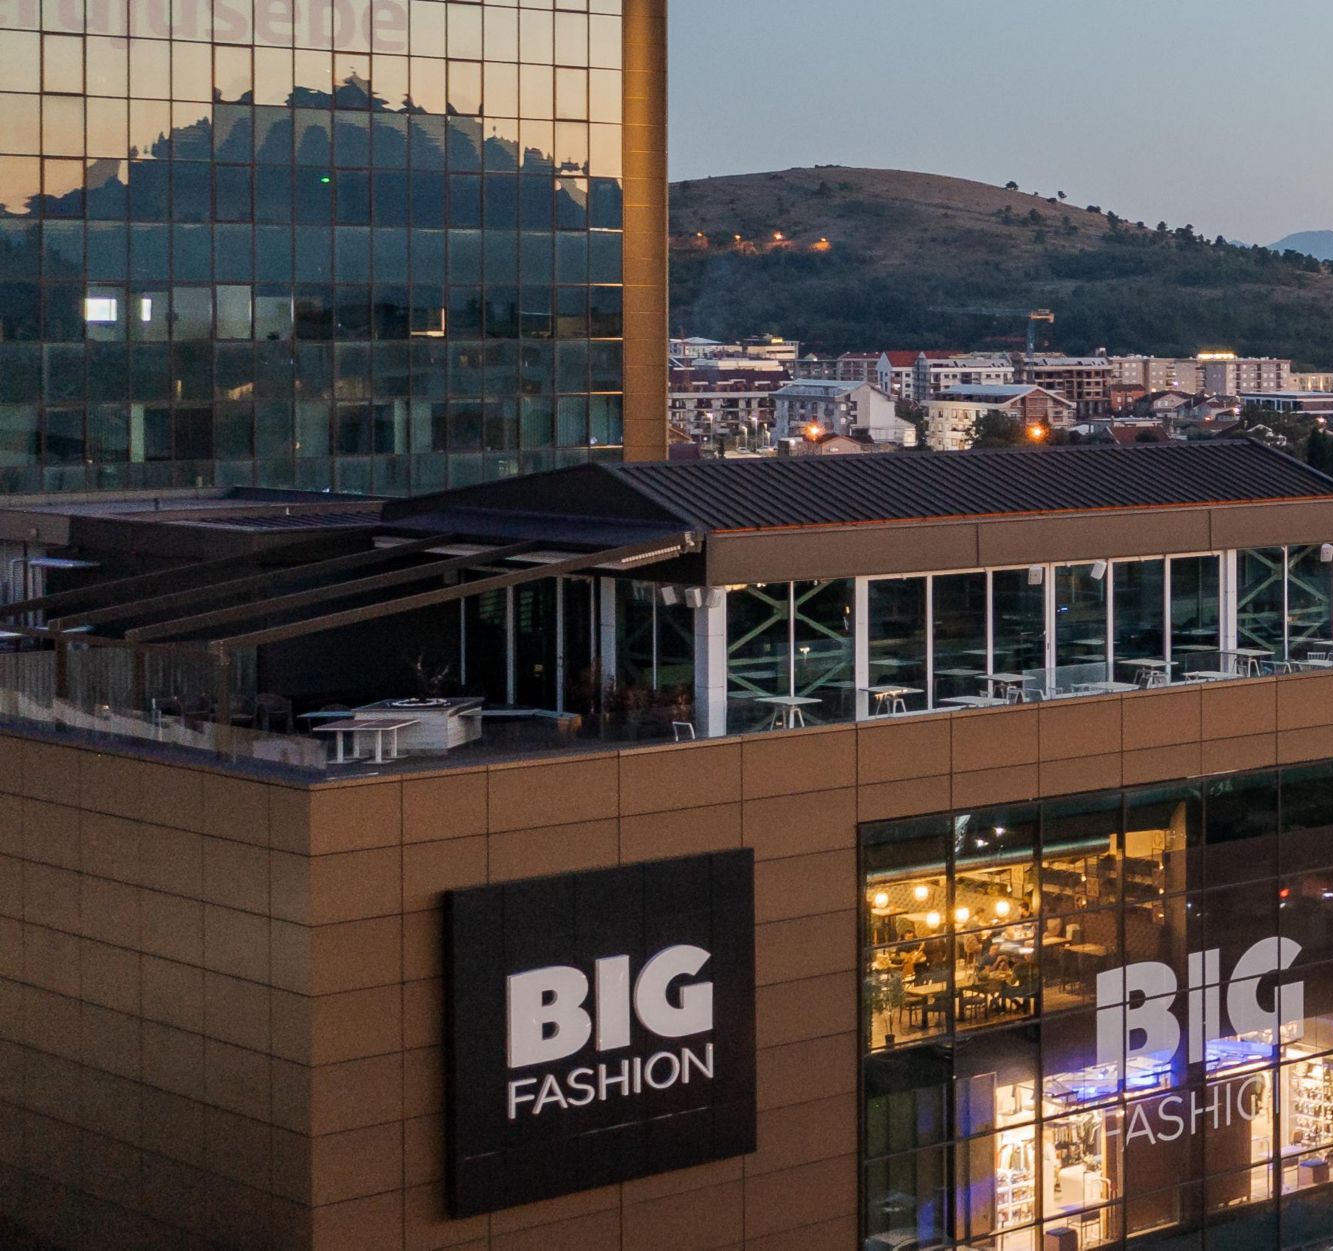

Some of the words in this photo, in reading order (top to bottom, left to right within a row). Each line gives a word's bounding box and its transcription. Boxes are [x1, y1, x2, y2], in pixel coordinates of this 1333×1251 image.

[506, 944, 714, 1069] BIG
[1096, 936, 1305, 1084] BIG
[508, 1043, 714, 1120] FASHION
